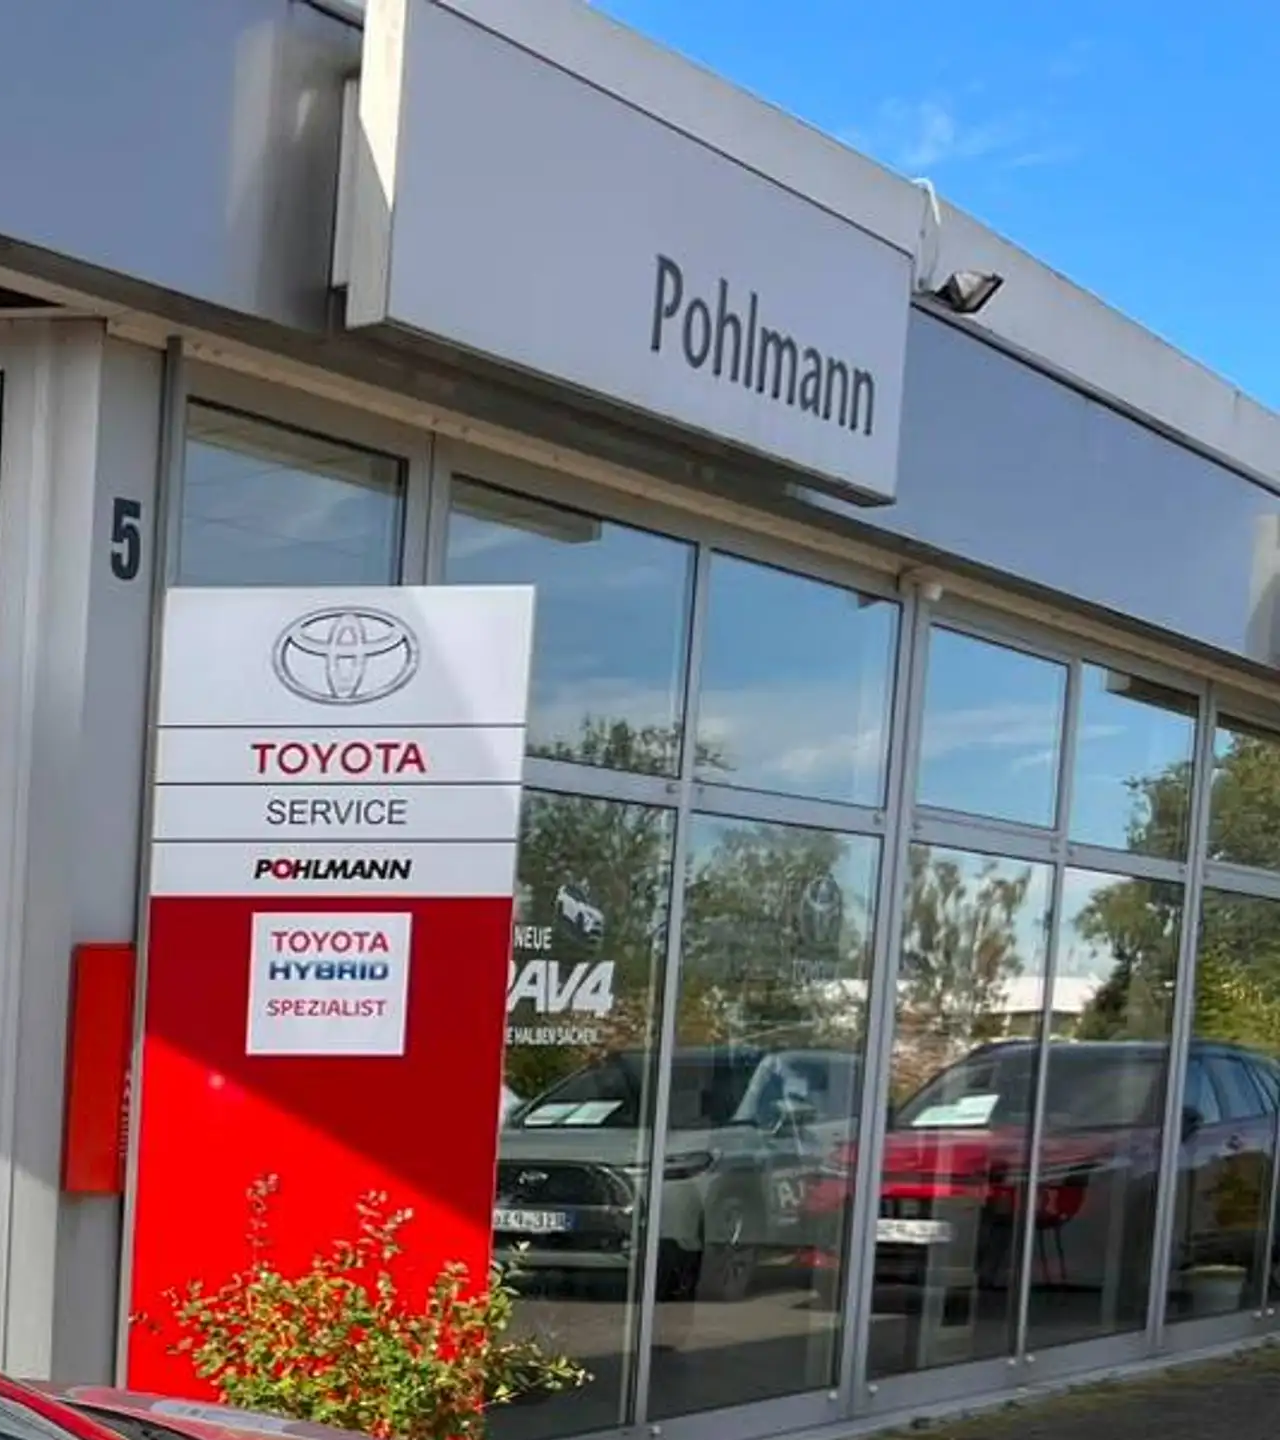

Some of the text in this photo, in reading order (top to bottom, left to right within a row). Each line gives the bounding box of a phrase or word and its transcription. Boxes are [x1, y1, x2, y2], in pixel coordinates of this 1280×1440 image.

[650, 252, 875, 437] Pohlmann
[110, 497, 141, 581] 5
[251, 742, 427, 774] TOYOTA
[266, 798, 408, 825] SERVICE
[254, 858, 413, 880] POHLMANN
[271, 930, 390, 953] TOYOTA
[514, 926, 552, 950] NEUE
[268, 960, 389, 981] HYBRID
[266, 999, 388, 1017] SPEZIALIST
